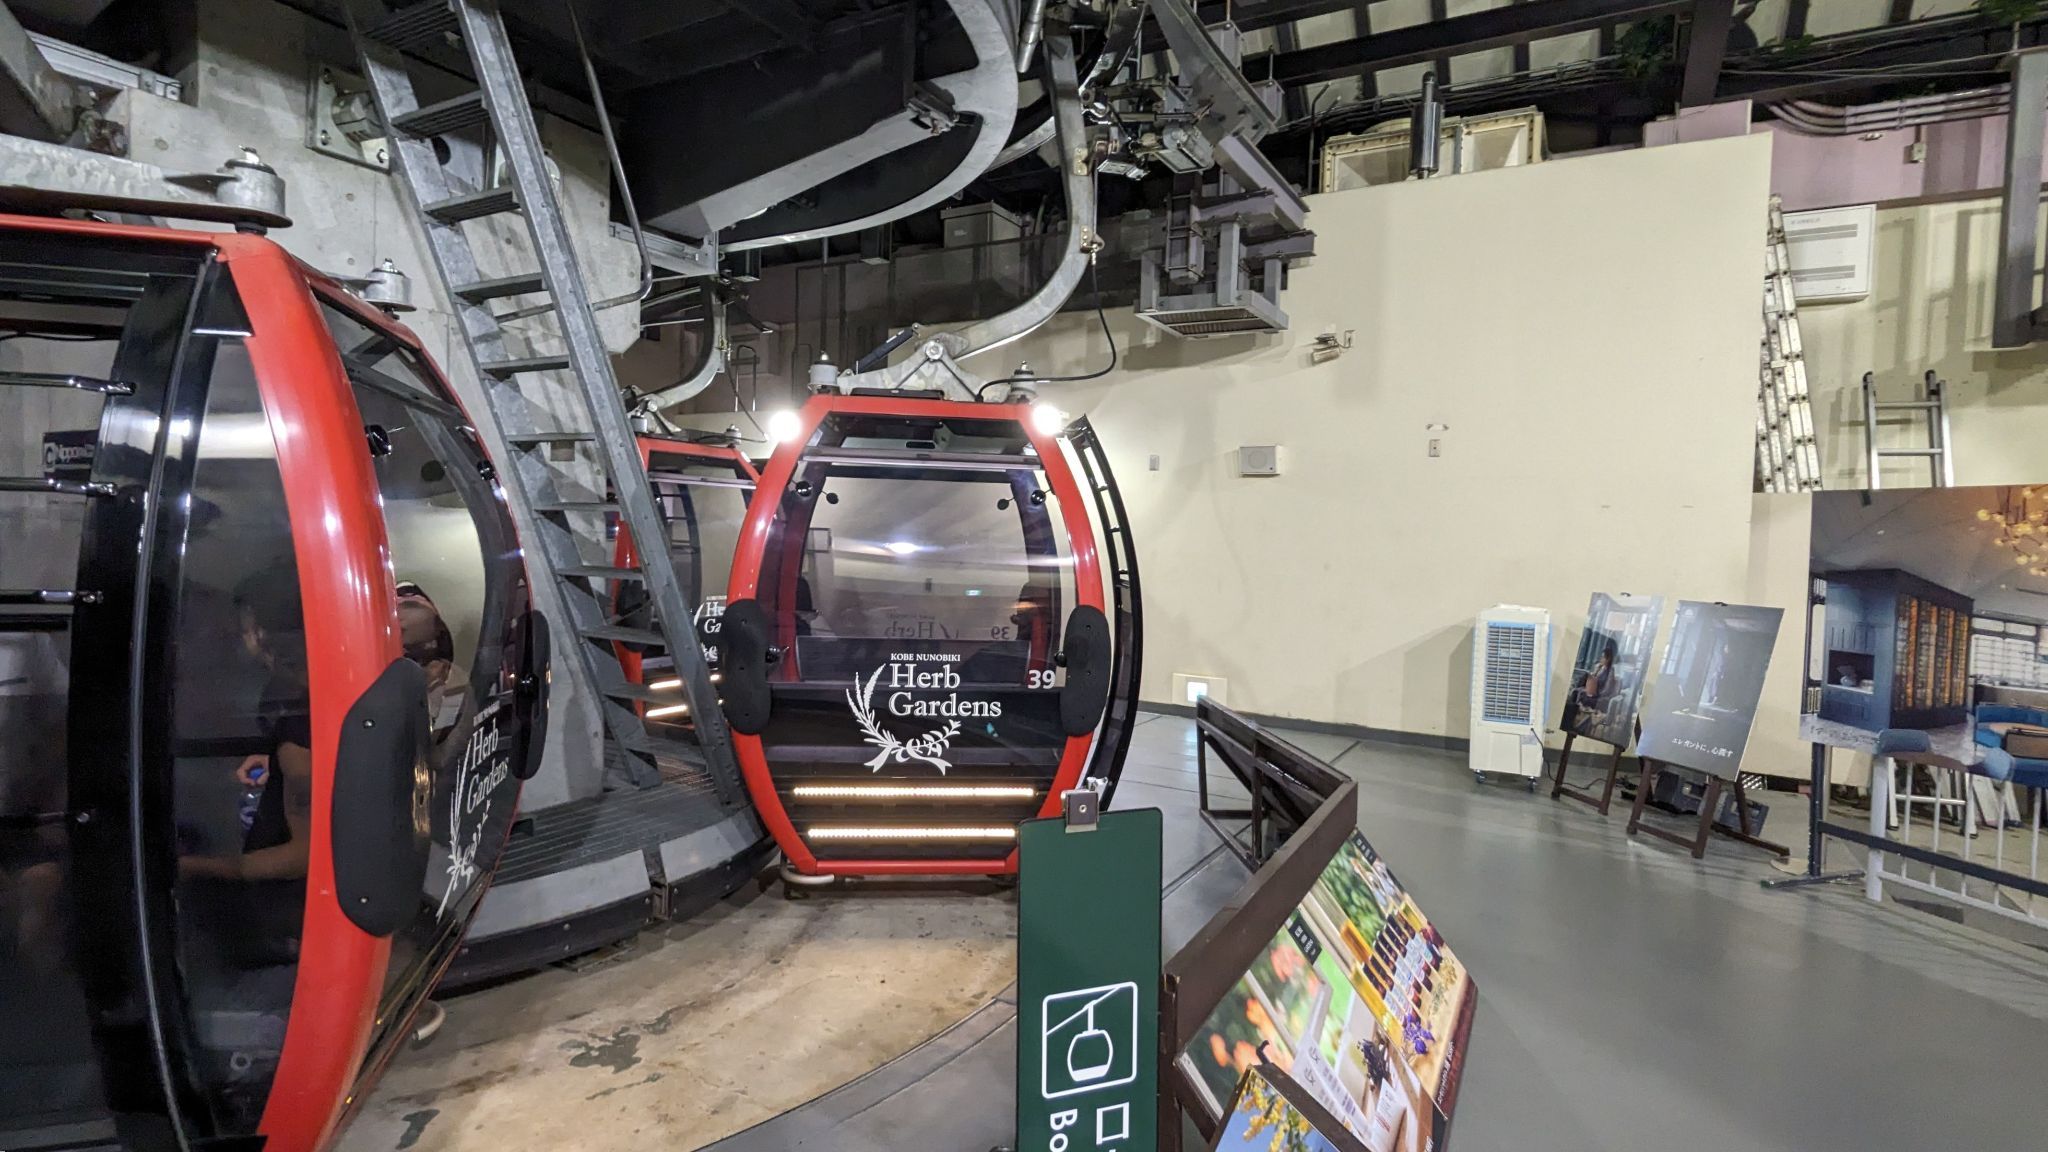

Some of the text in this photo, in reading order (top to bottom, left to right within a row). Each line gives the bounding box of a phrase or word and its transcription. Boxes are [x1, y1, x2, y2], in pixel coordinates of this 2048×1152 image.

[890, 653, 961, 662] KOBE NUNOBIKI
[889, 663, 961, 689] Herb
[1027, 669, 1056, 689] 39
[888, 692, 1002, 717] Gardens
[470, 717, 499, 771] Herb
[467, 757, 509, 814] Gardens
